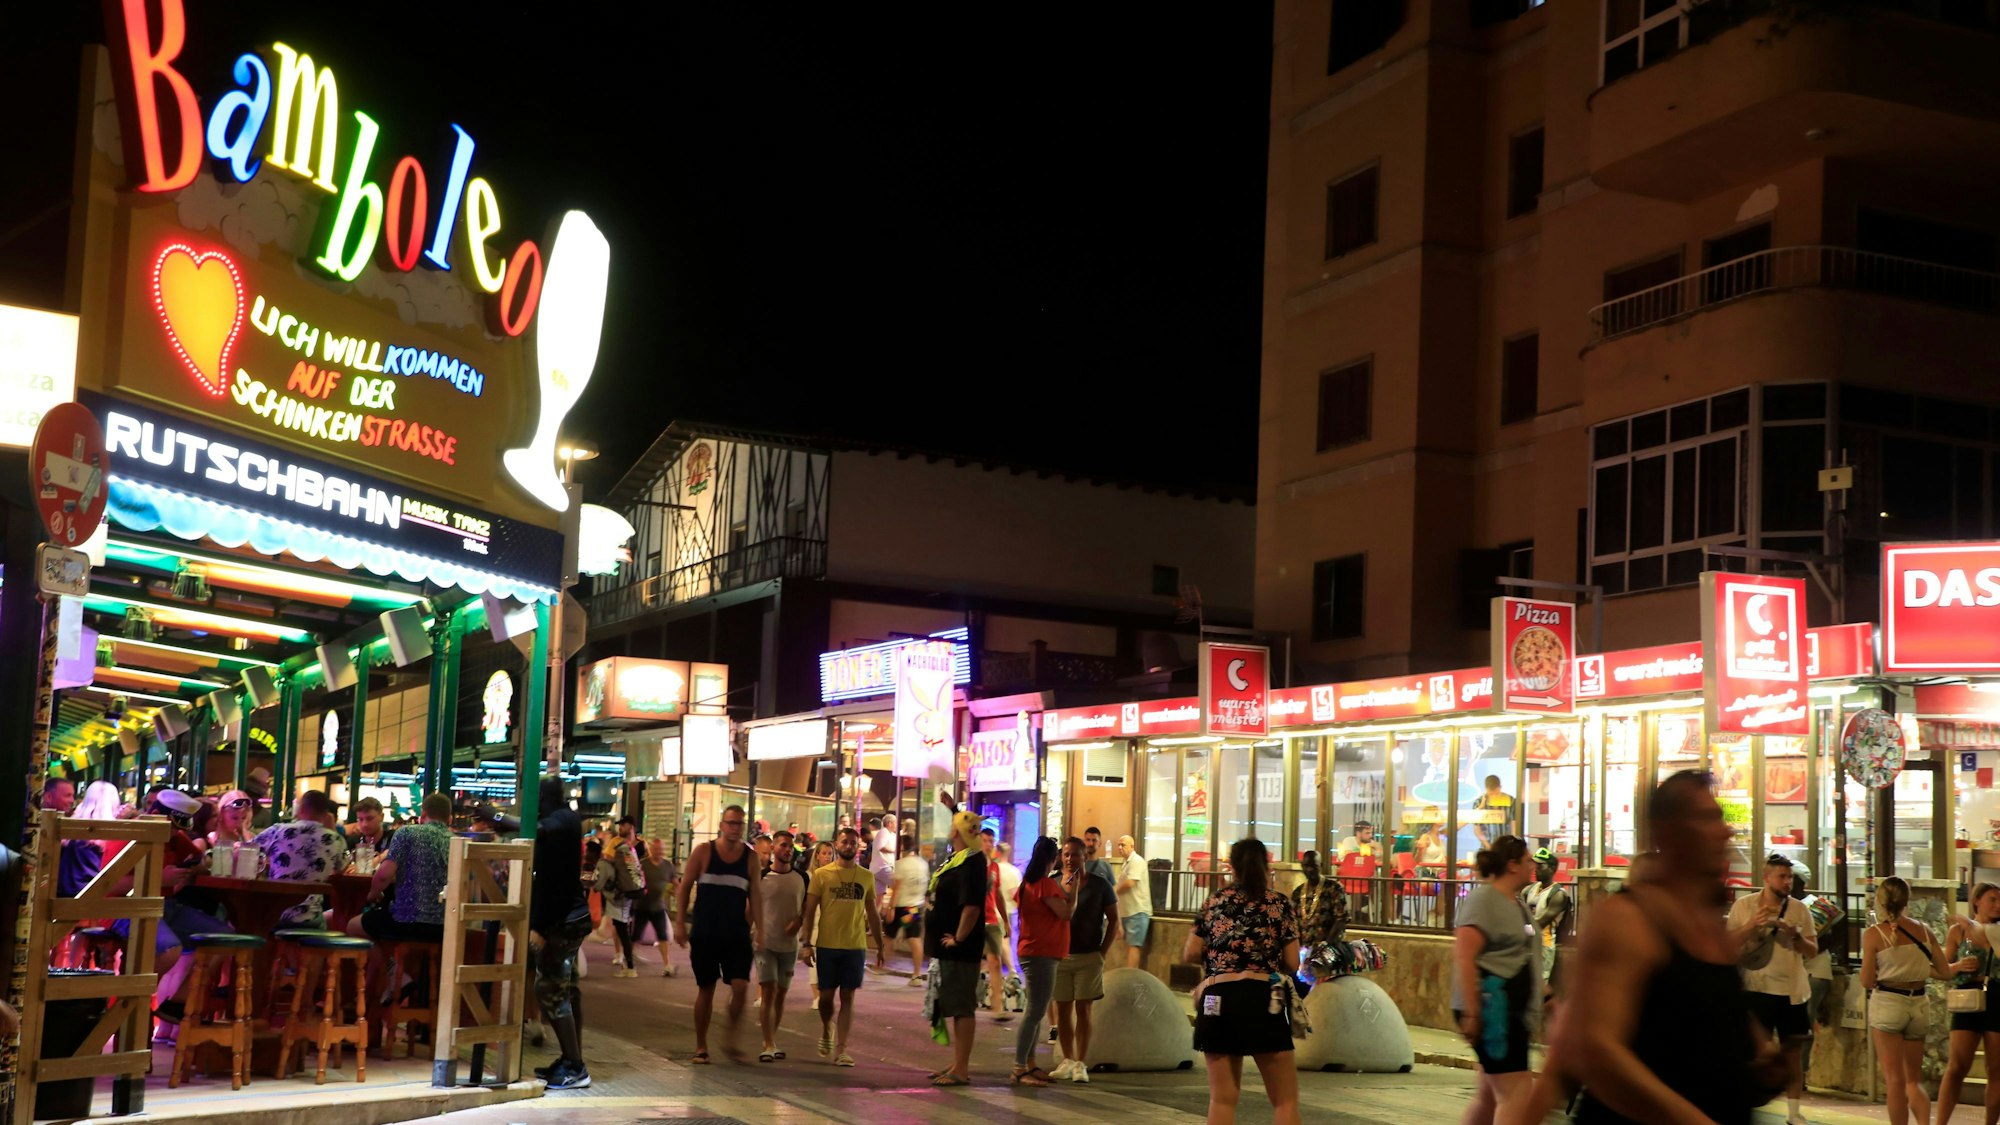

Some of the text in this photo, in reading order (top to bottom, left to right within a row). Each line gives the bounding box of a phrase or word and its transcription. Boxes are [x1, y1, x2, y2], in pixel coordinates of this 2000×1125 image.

[122, 0, 543, 337] Bamboleo
[287, 360, 397, 411] AUF DER
[323, 331, 485, 397] WILLKOMMEN
[230, 367, 458, 466] SCHINKENSTRASSE
[105, 411, 401, 529] RUTSCHBAHN
[403, 498, 449, 525] MUSIK
[1904, 567, 2000, 607] DAS
[1514, 603, 1560, 625] Pizza
[1212, 711, 1263, 727] meister
[1218, 698, 1258, 711] wurst
